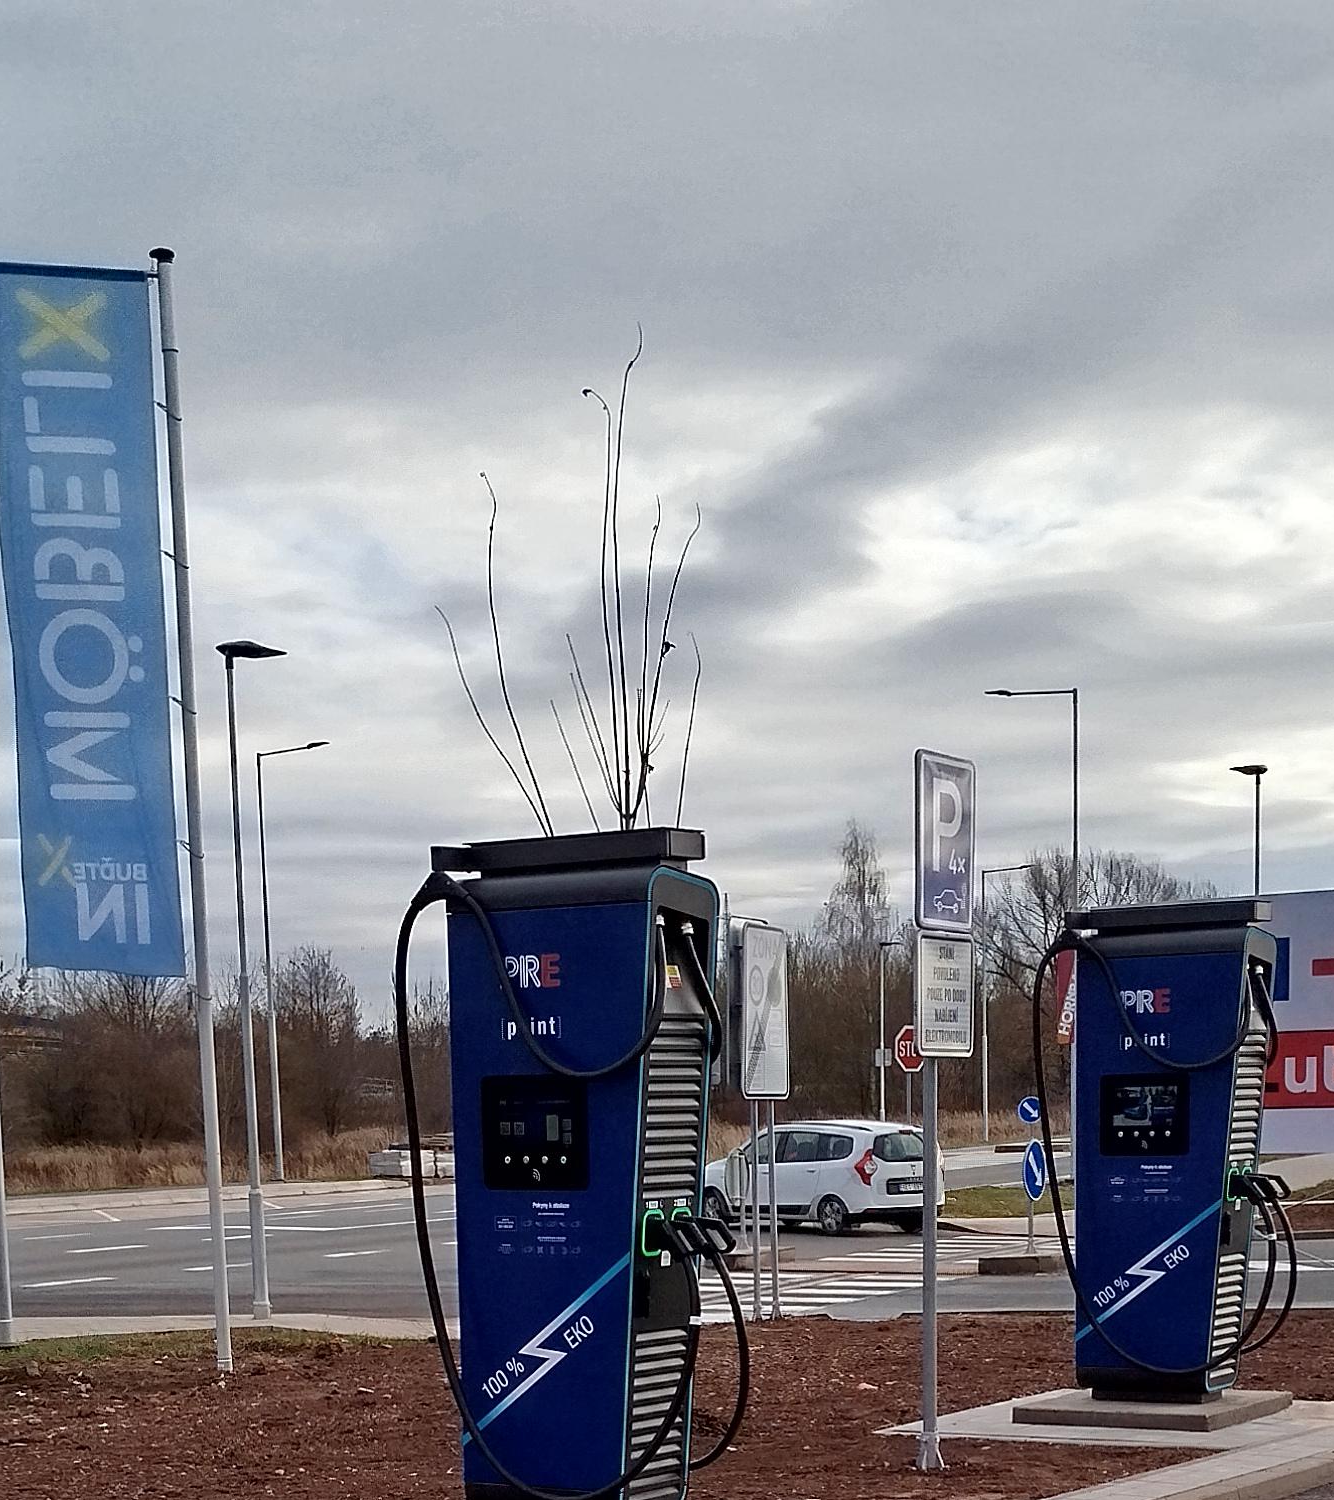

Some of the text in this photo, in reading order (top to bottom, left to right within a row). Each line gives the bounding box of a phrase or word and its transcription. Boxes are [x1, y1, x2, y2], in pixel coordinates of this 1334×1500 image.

[933, 777, 963, 873] P
[948, 848, 966, 875] 4x
[505, 953, 561, 988] PRE
[1120, 988, 1171, 1014] PRE
[1163, 1244, 1190, 1270] EKO
[1093, 1275, 1130, 1308] 100 %
[563, 1315, 594, 1349] EKO
[482, 1356, 525, 1399] 100 %
